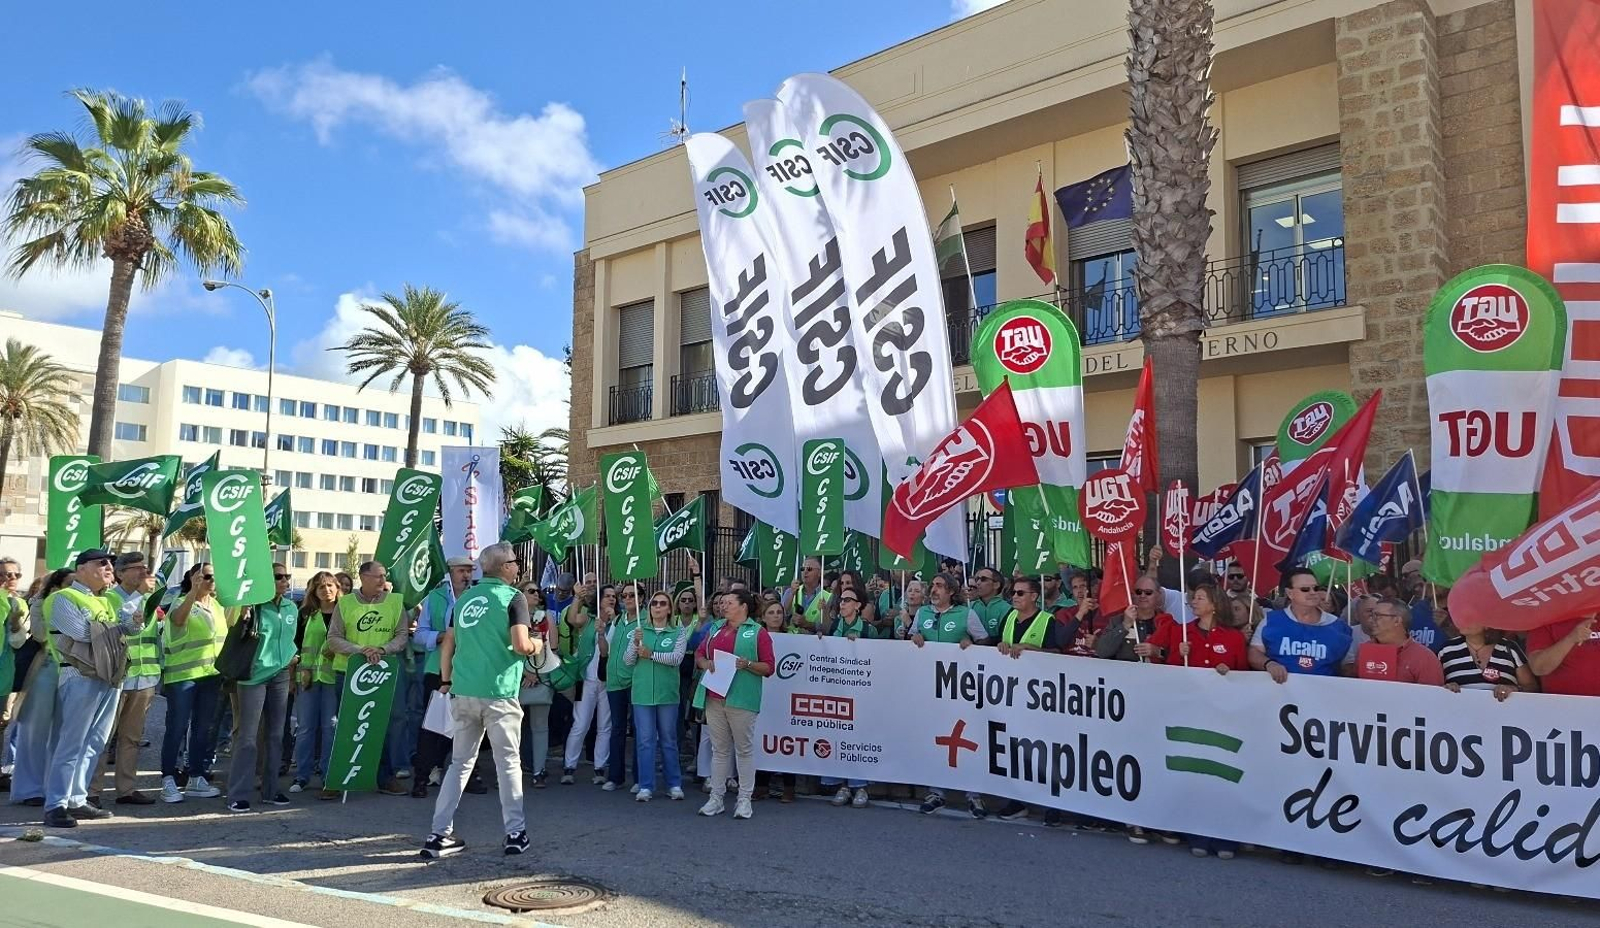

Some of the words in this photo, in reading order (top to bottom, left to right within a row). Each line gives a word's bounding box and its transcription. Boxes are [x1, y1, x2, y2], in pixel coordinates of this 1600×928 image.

[1085, 353, 1128, 374] DEL
[1208, 332, 1278, 357] ERNO
[813, 452, 839, 464] CSIF
[613, 466, 642, 481] CSIF
[219, 485, 254, 501] CSIF
[405, 482, 436, 497] CSIF
[1086, 474, 1133, 507] UGT
[815, 478, 830, 551] CSIF
[392, 509, 418, 560] CSI
[622, 495, 639, 575] CSIF
[229, 515, 253, 601] CSIF
[1409, 626, 1435, 647] caip
[1279, 636, 1327, 661] Acaip
[781, 660, 804, 671] CSIF
[809, 654, 838, 664] Central
[839, 656, 871, 666] Sindical
[361, 670, 392, 684] CSIF
[809, 665, 864, 676] Independiente
[866, 669, 872, 677] y
[809, 674, 819, 682] de
[821, 676, 872, 687] Funcionarios
[935, 660, 1018, 709] Mejor
[1026, 672, 1125, 722] salario
[795, 697, 850, 716] CCOO
[790, 716, 813, 727] área
[816, 718, 854, 731] pública
[342, 700, 376, 785] CSIF
[763, 734, 809, 757] UGT
[840, 741, 882, 753] Servicios
[1279, 703, 1485, 778] Servicios
[840, 752, 879, 763] Públicos
[987, 720, 1141, 801] Empleo
[1283, 766, 1362, 833] de
